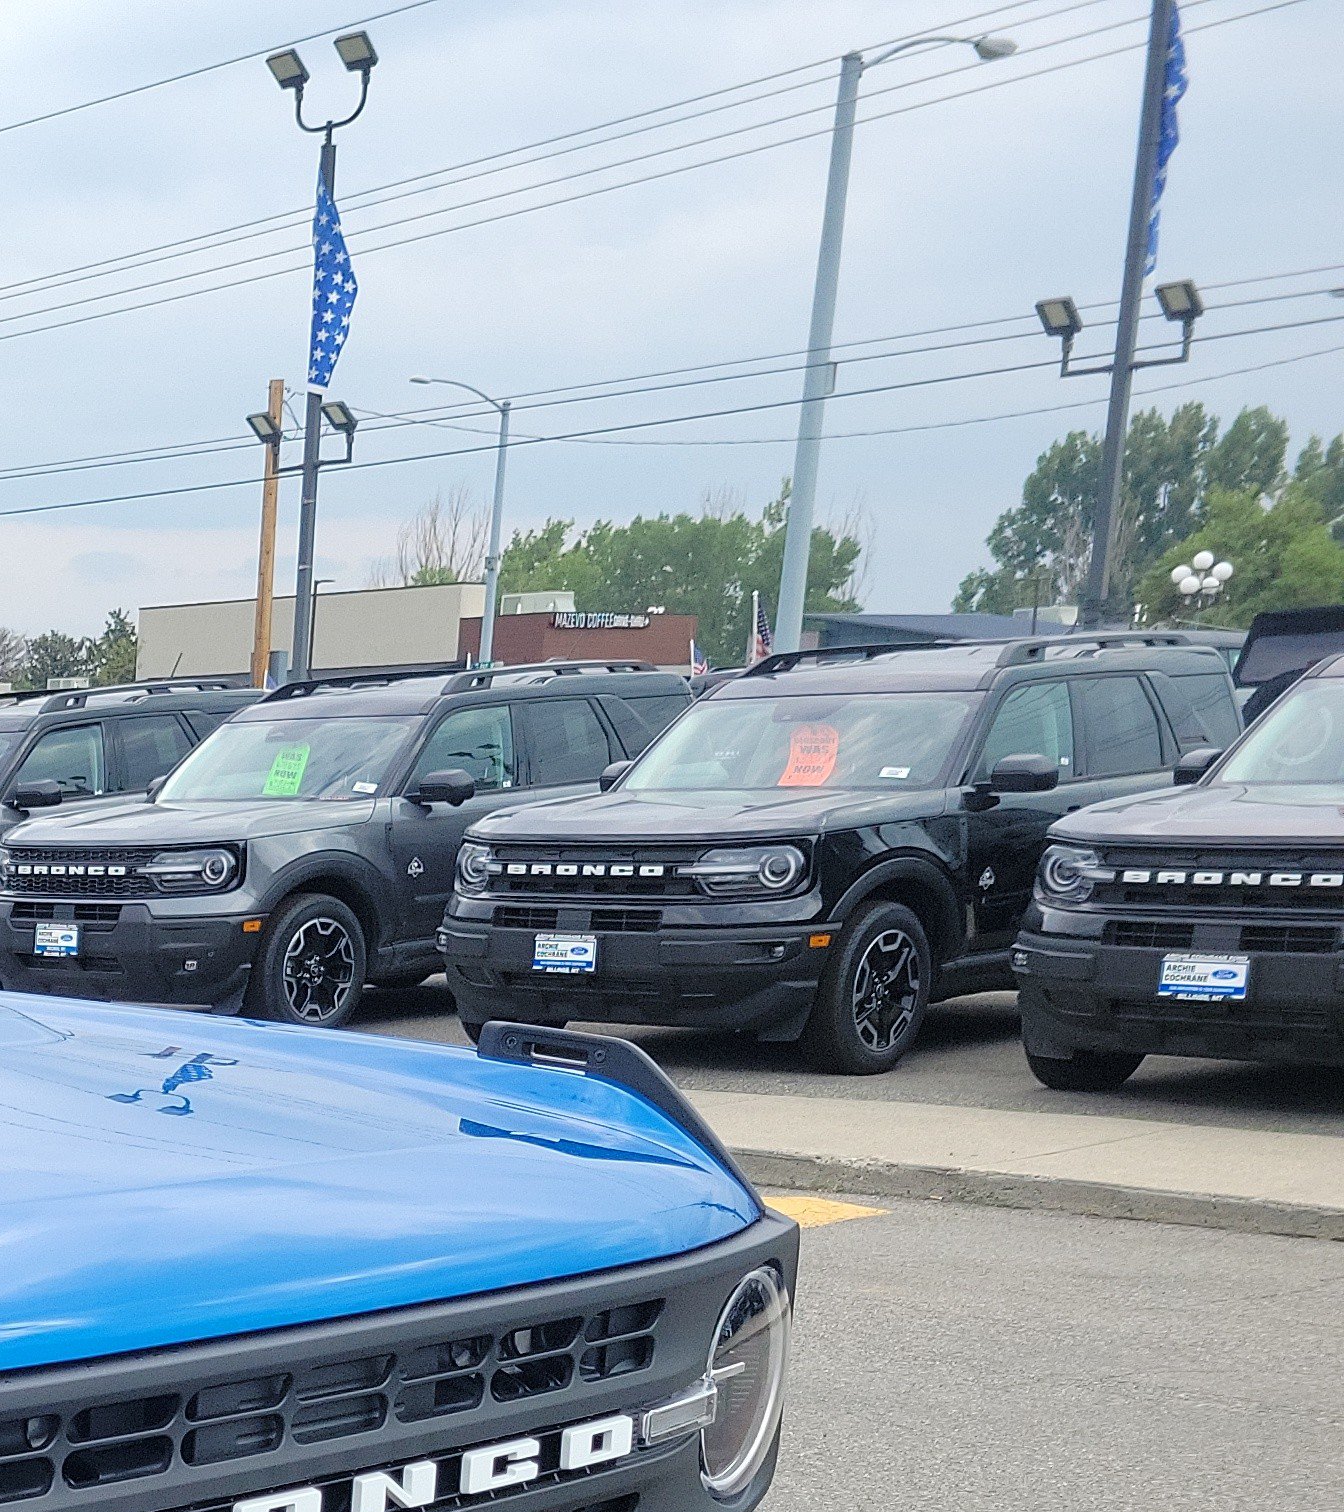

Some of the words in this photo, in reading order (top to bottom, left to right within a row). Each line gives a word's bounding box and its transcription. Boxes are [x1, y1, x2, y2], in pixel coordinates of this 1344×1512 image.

[587, 612, 613, 629] COFFEE
[17, 866, 126, 875] BRONCO
[507, 864, 664, 876] BRONCO
[1123, 870, 1344, 887] BRONCO
[1166, 964, 1196, 973] ARCHIE
[1164, 974, 1209, 983] COCHRANE
